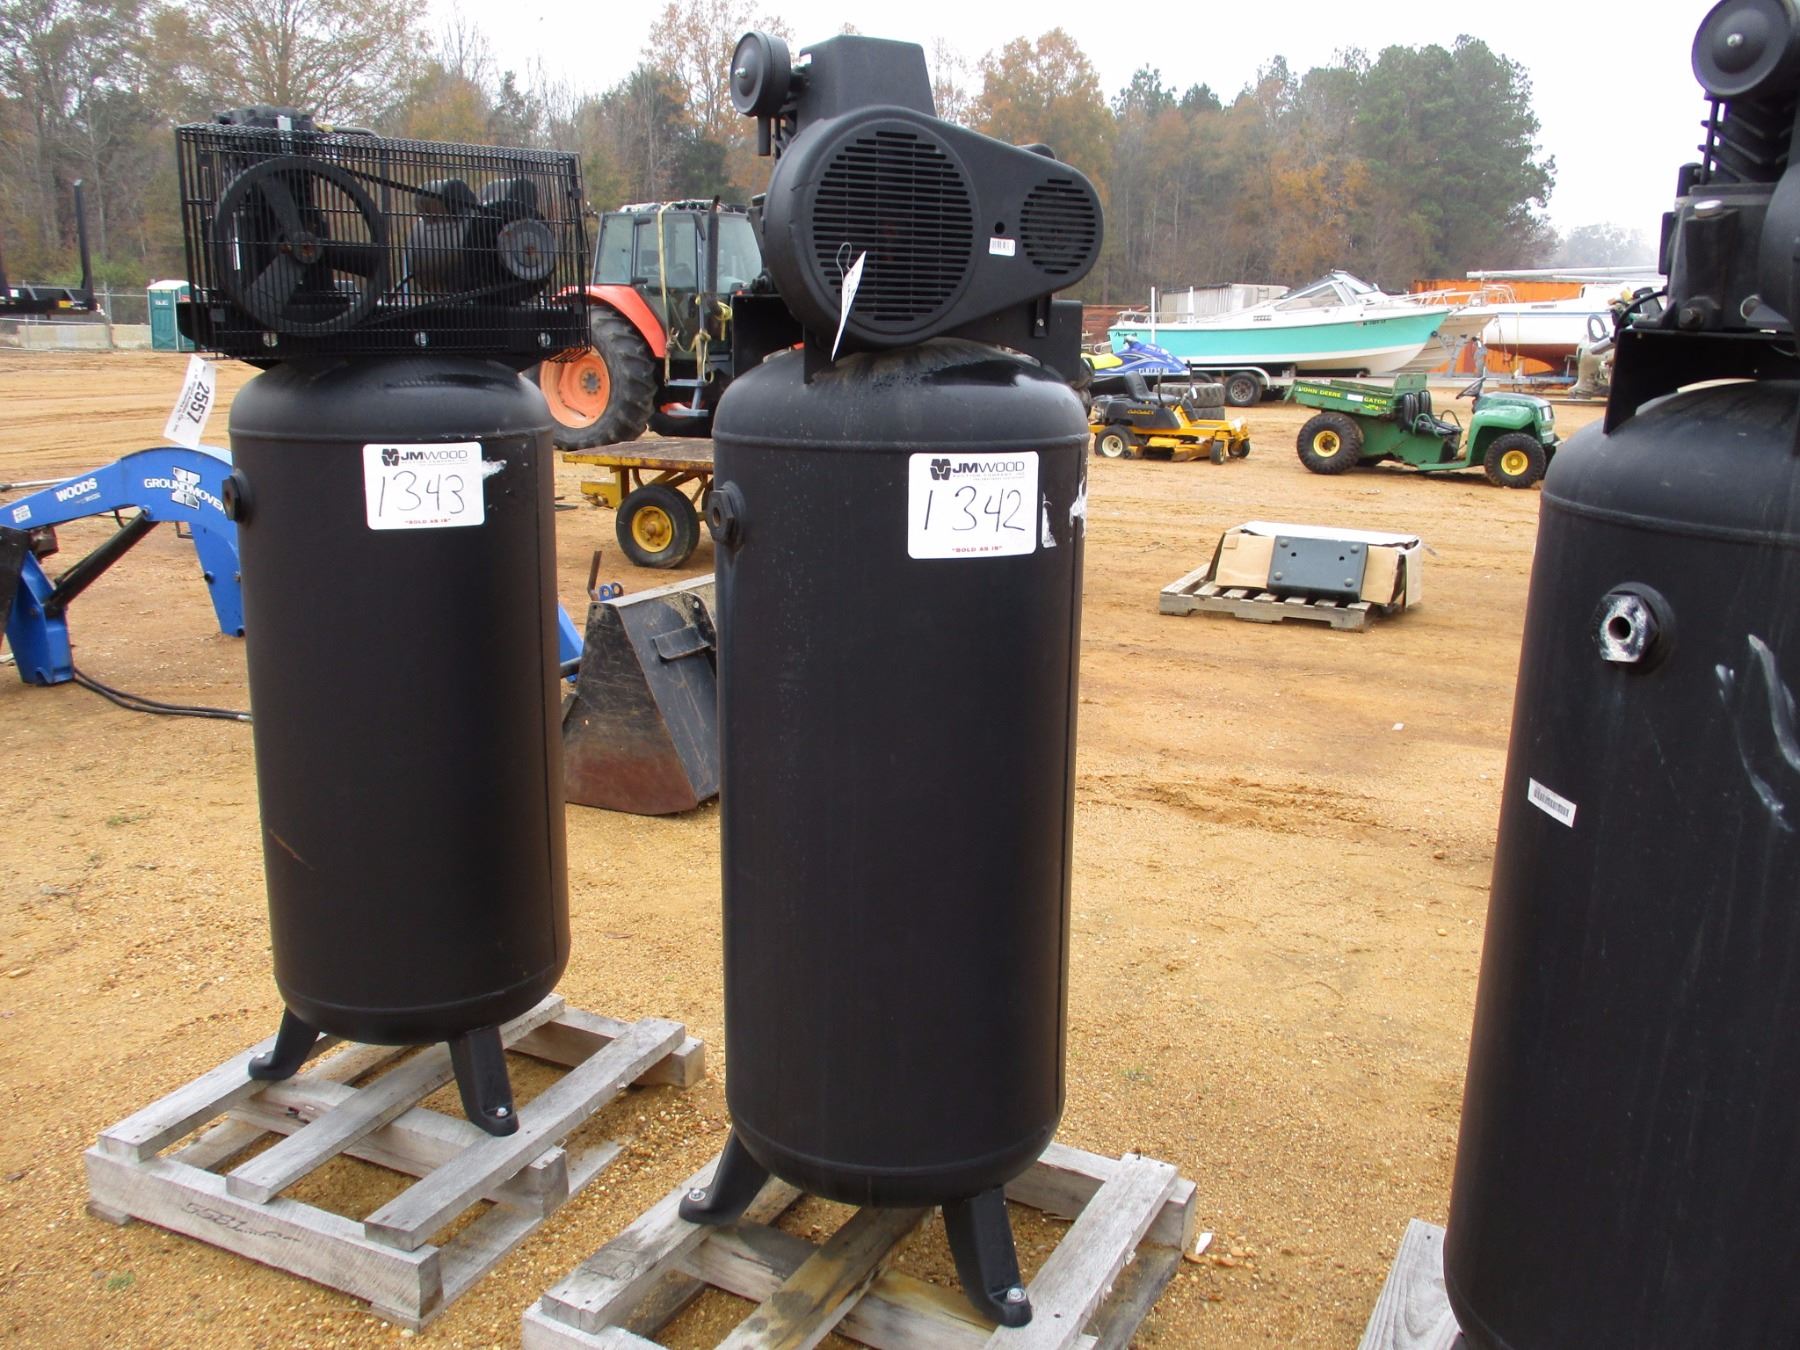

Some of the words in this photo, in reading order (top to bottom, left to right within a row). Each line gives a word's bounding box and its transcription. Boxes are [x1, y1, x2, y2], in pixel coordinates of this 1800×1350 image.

[187, 381, 211, 424] 2557
[1319, 389, 1341, 398] DEERE
[1363, 395, 1387, 405] GATOR
[401, 450, 467, 461] JMWOOD
[952, 461, 1025, 473] JMWOOD
[55, 477, 98, 502] WOODS
[379, 471, 465, 517] 1343
[924, 486, 1025, 532] 1342
